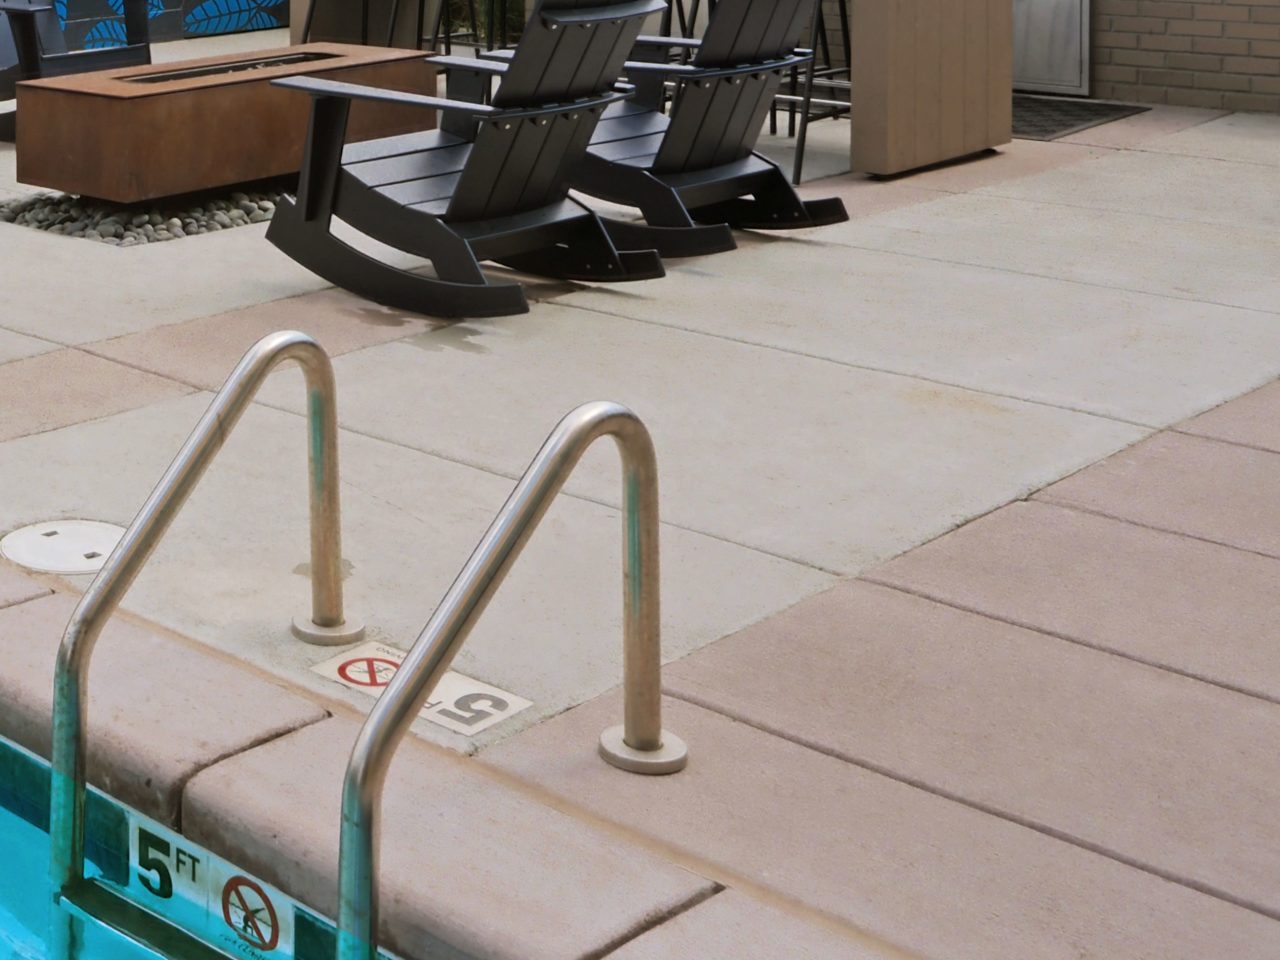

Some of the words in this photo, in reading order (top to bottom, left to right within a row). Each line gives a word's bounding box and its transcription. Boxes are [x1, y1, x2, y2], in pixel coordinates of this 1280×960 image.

[436, 692, 510, 726] 5
[137, 826, 173, 899] 5
[176, 847, 200, 883] FT
